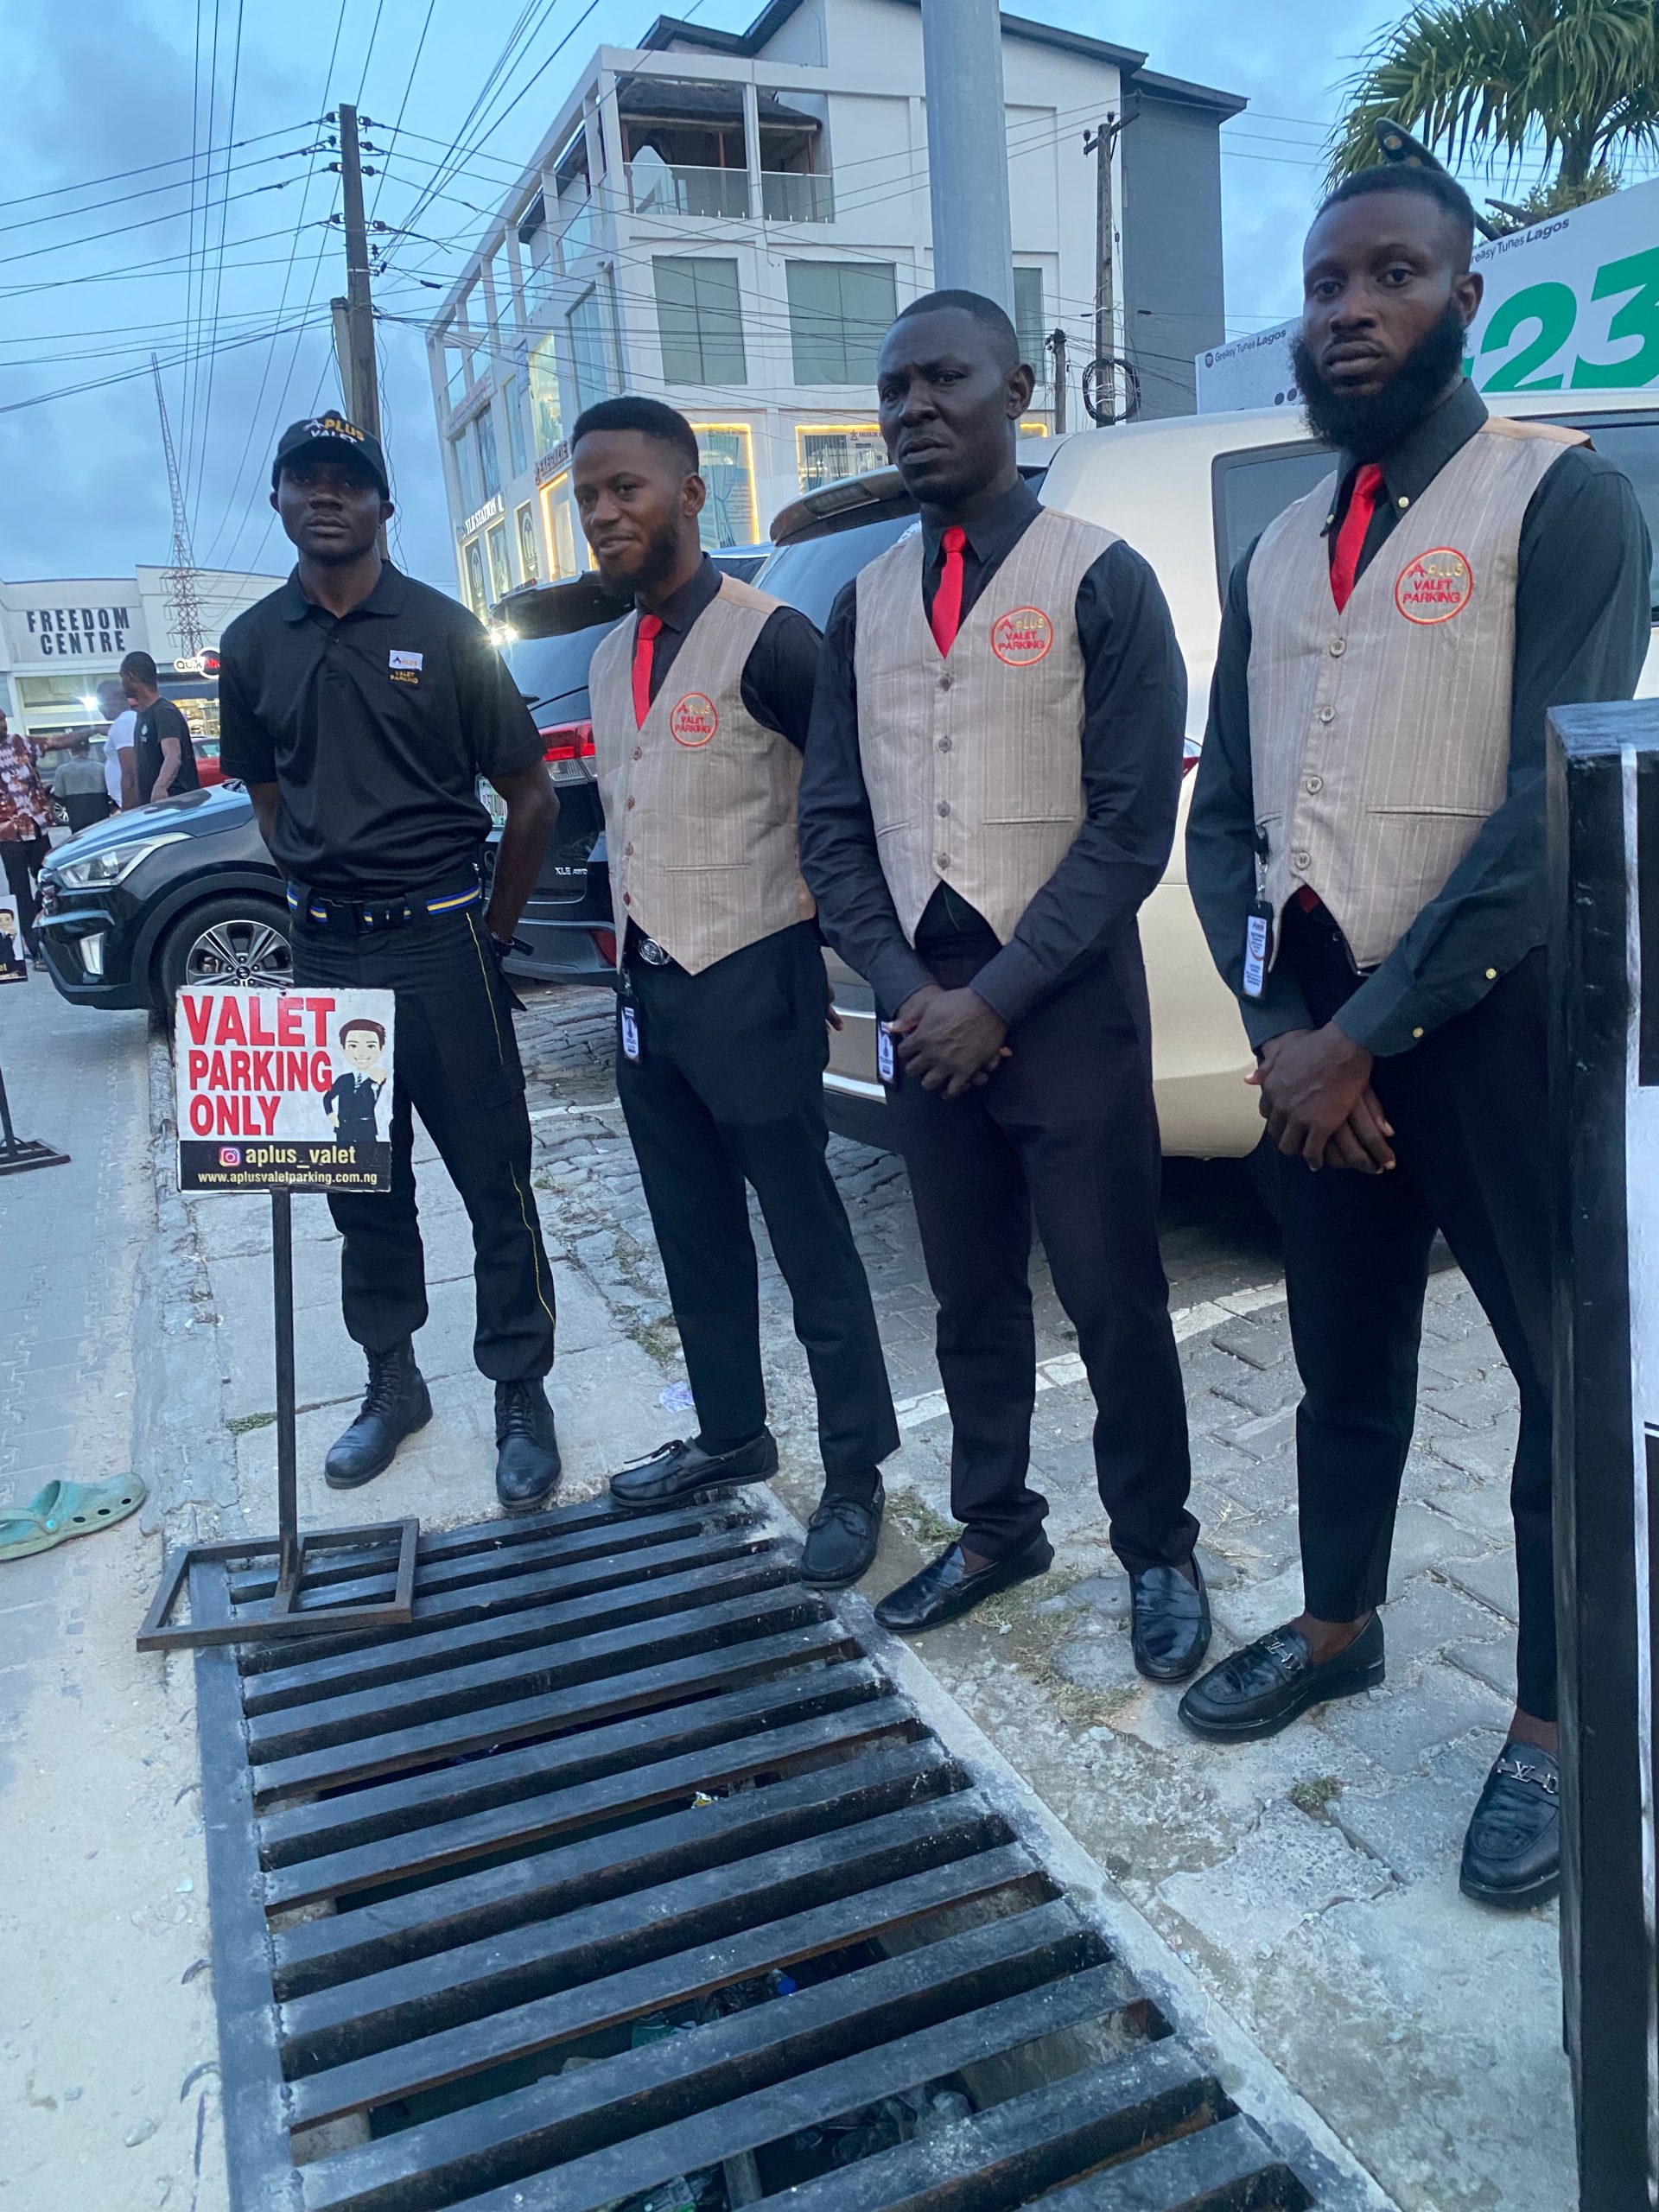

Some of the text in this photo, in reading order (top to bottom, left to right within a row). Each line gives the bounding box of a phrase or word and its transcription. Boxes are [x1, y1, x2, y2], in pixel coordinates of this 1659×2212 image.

[1471, 218, 1569, 264] reasy Tunes Lagos
[1215, 329, 1287, 362] Greasy Tunes Lagos
[1414, 579, 1452, 591] VALET
[1403, 592, 1460, 604] PARKING
[26, 607, 130, 632] FREEDOM
[40, 631, 125, 655] CENTRE
[1006, 630, 1037, 641] VALET
[999, 639, 1045, 651] PARKING
[390, 674, 418, 684] PARKING
[681, 715, 705, 724] VALET
[675, 724, 711, 734] PARKING
[555, 867, 571, 875] XLE
[181, 995, 335, 1047] VALET
[188, 1050, 332, 1092] PARKING
[189, 1094, 281, 1136] ONLY
[245, 1144, 356, 1169] aplus_valet
[198, 1171, 378, 1186] www.aplusvaletparking.com.ng
